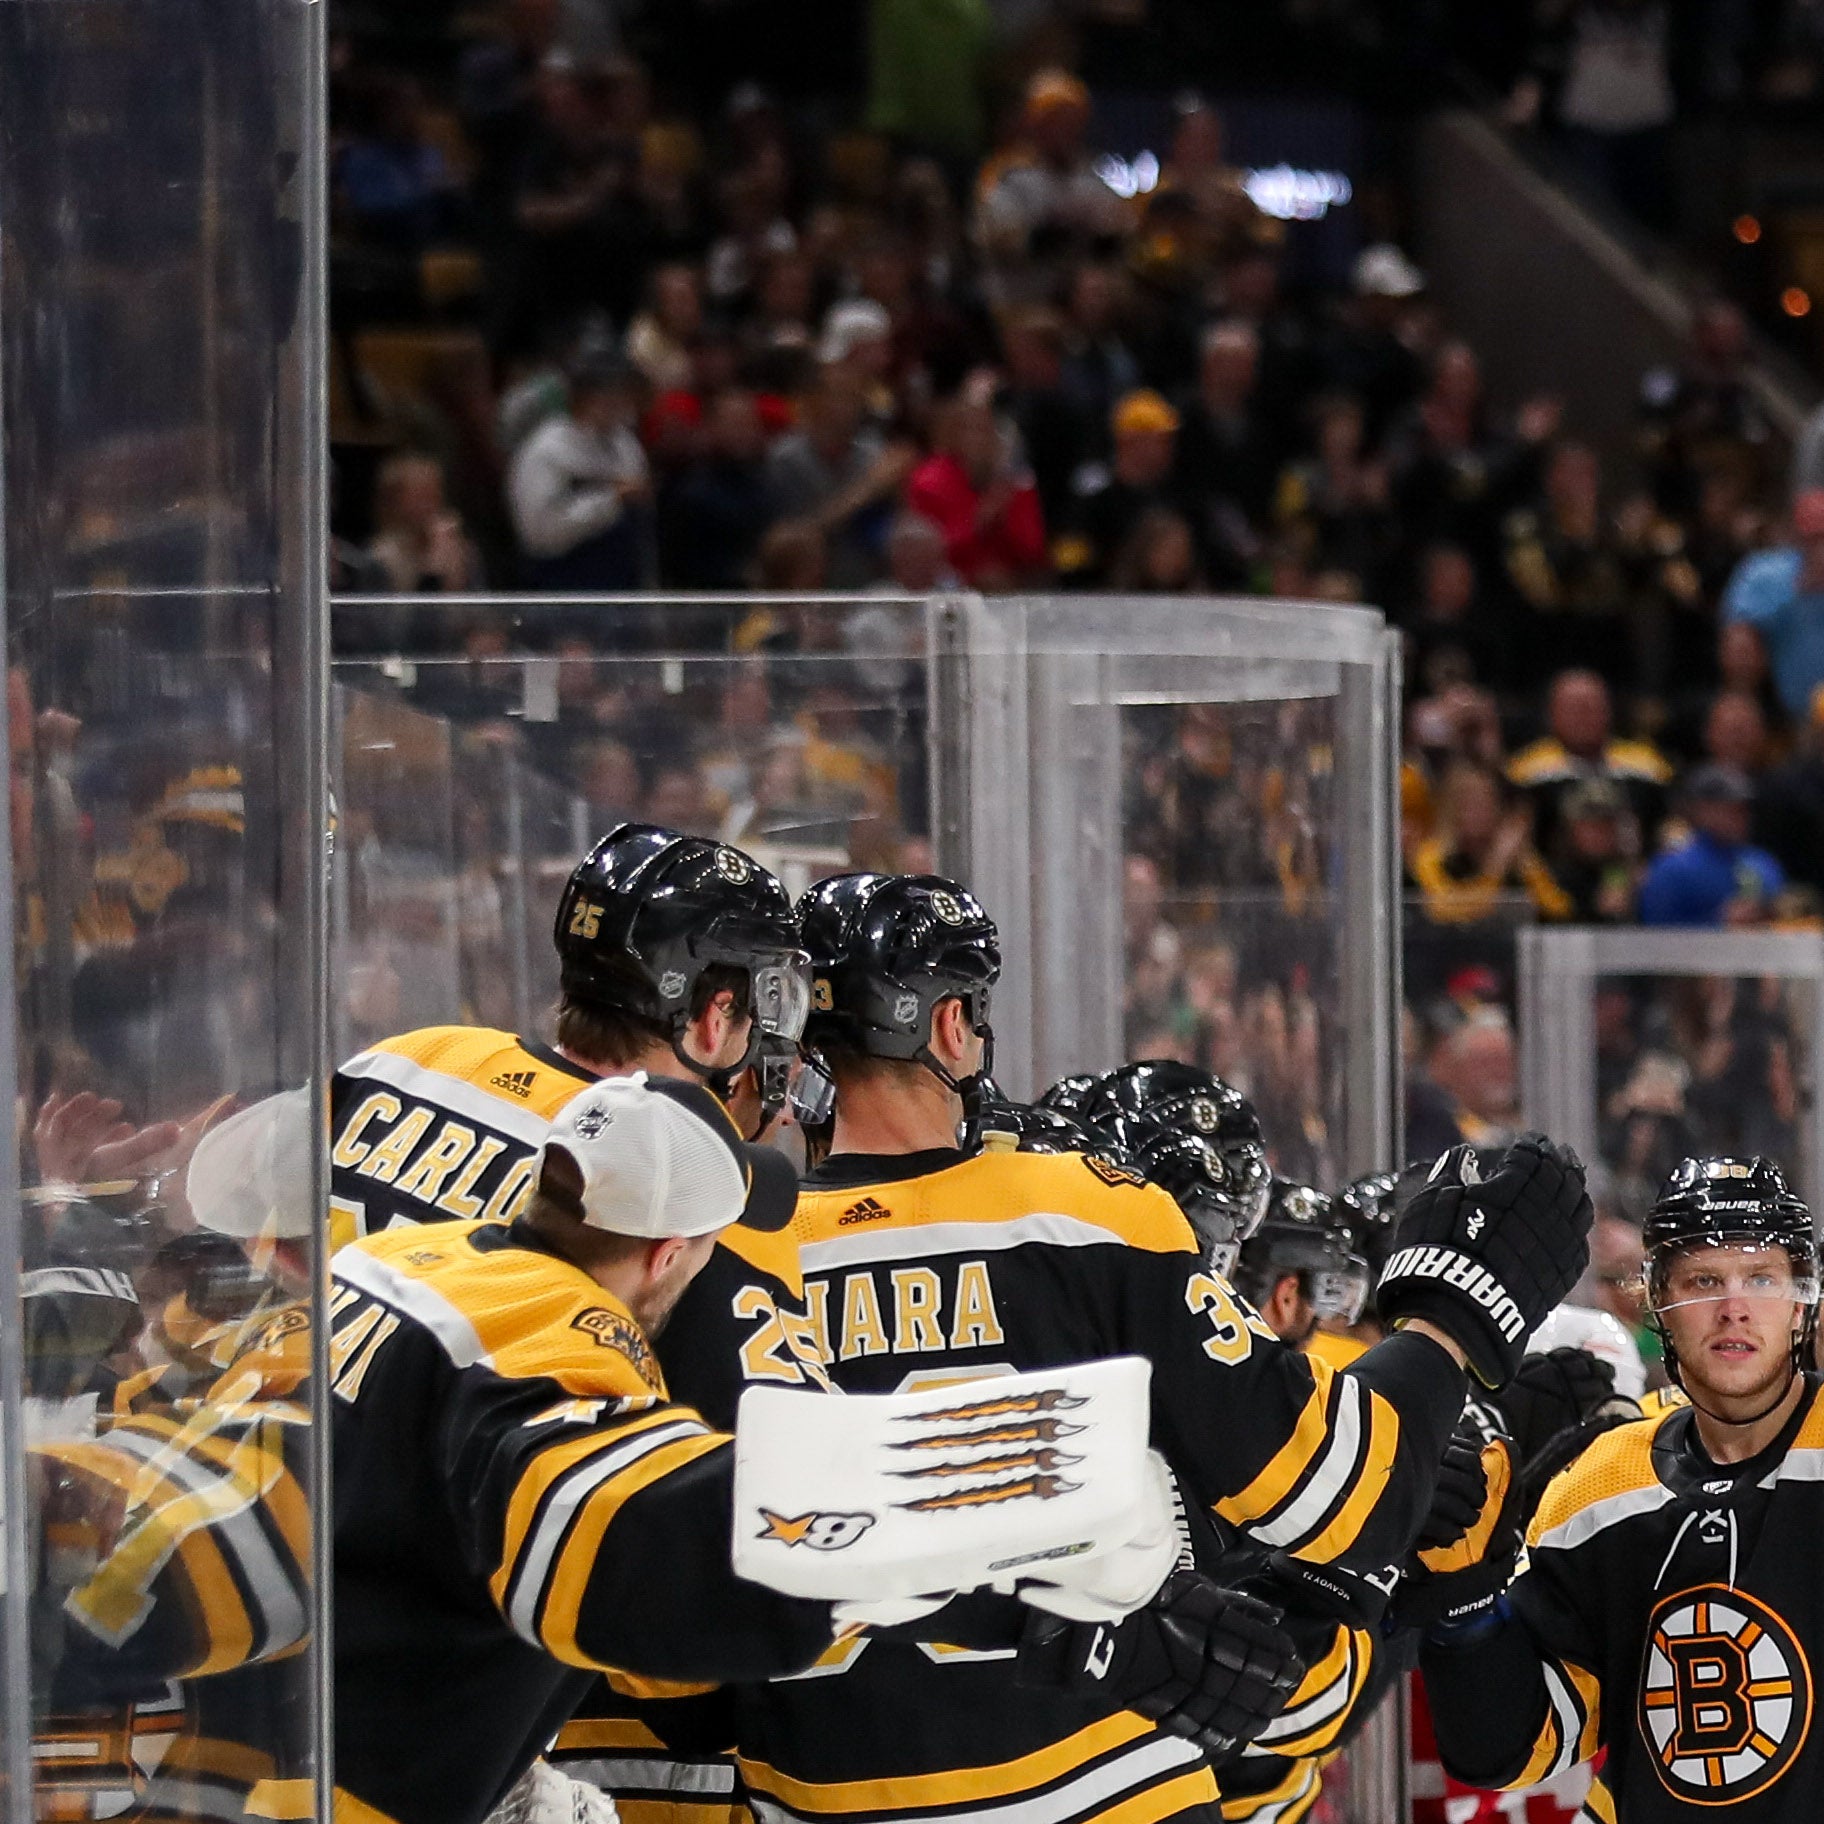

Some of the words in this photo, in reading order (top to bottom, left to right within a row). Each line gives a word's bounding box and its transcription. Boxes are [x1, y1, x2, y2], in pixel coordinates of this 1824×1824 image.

[569, 896, 605, 939] 25
[489, 1076, 532, 1099] adidas
[838, 1208, 892, 1227] adidas
[1312, 1577, 1351, 1601] MCAVOY
[1667, 1635, 1754, 1757] B
